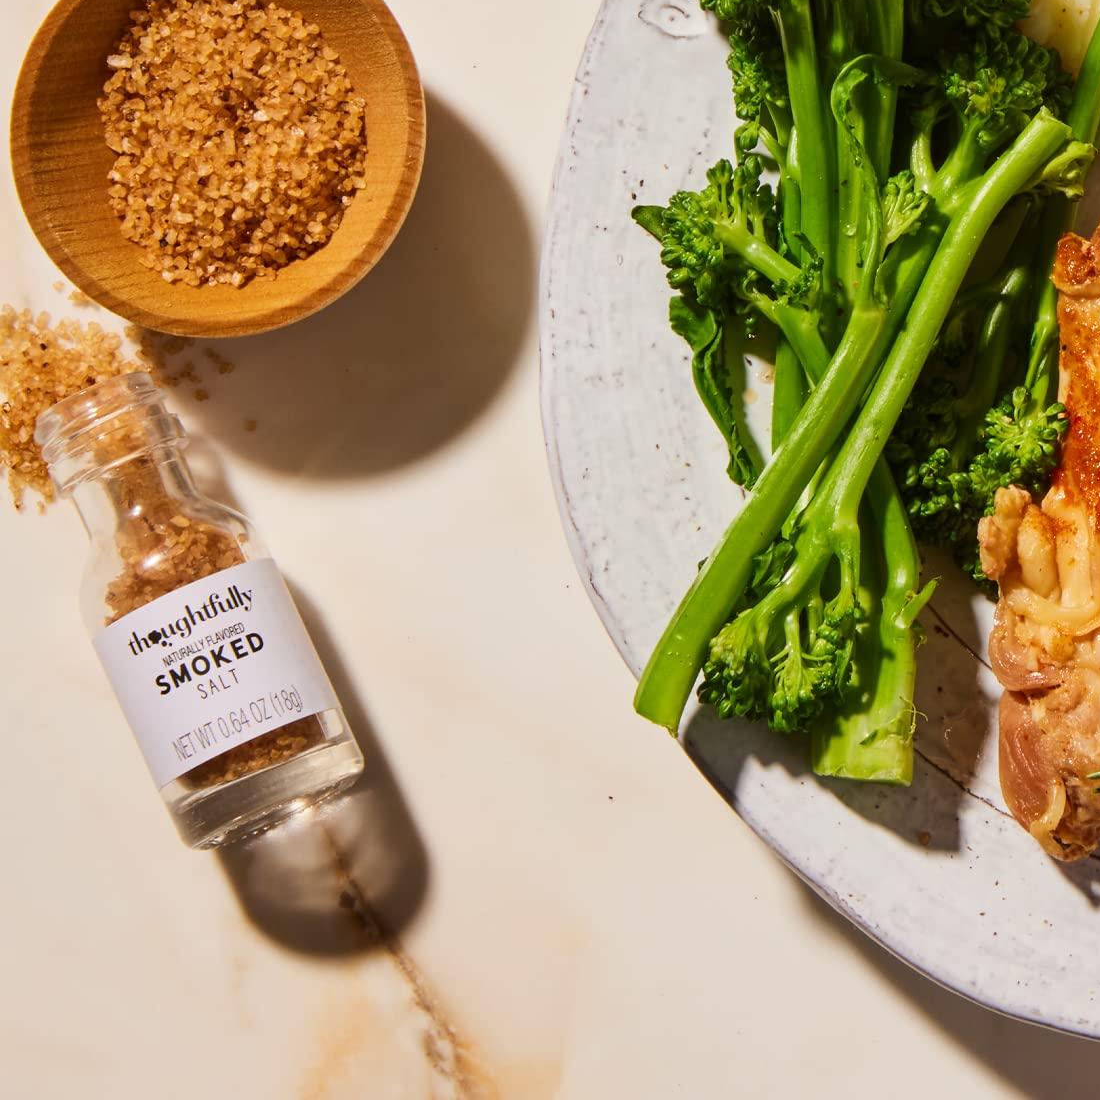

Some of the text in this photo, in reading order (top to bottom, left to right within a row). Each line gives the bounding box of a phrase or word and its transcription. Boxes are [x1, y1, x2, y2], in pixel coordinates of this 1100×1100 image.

[155, 632, 265, 695] SMOKED
[162, 622, 245, 667] NATURALLY FLAVORED
[197, 668, 239, 700] SALT
[172, 684, 304, 761] NET WT 0.64 OZ (18g)
